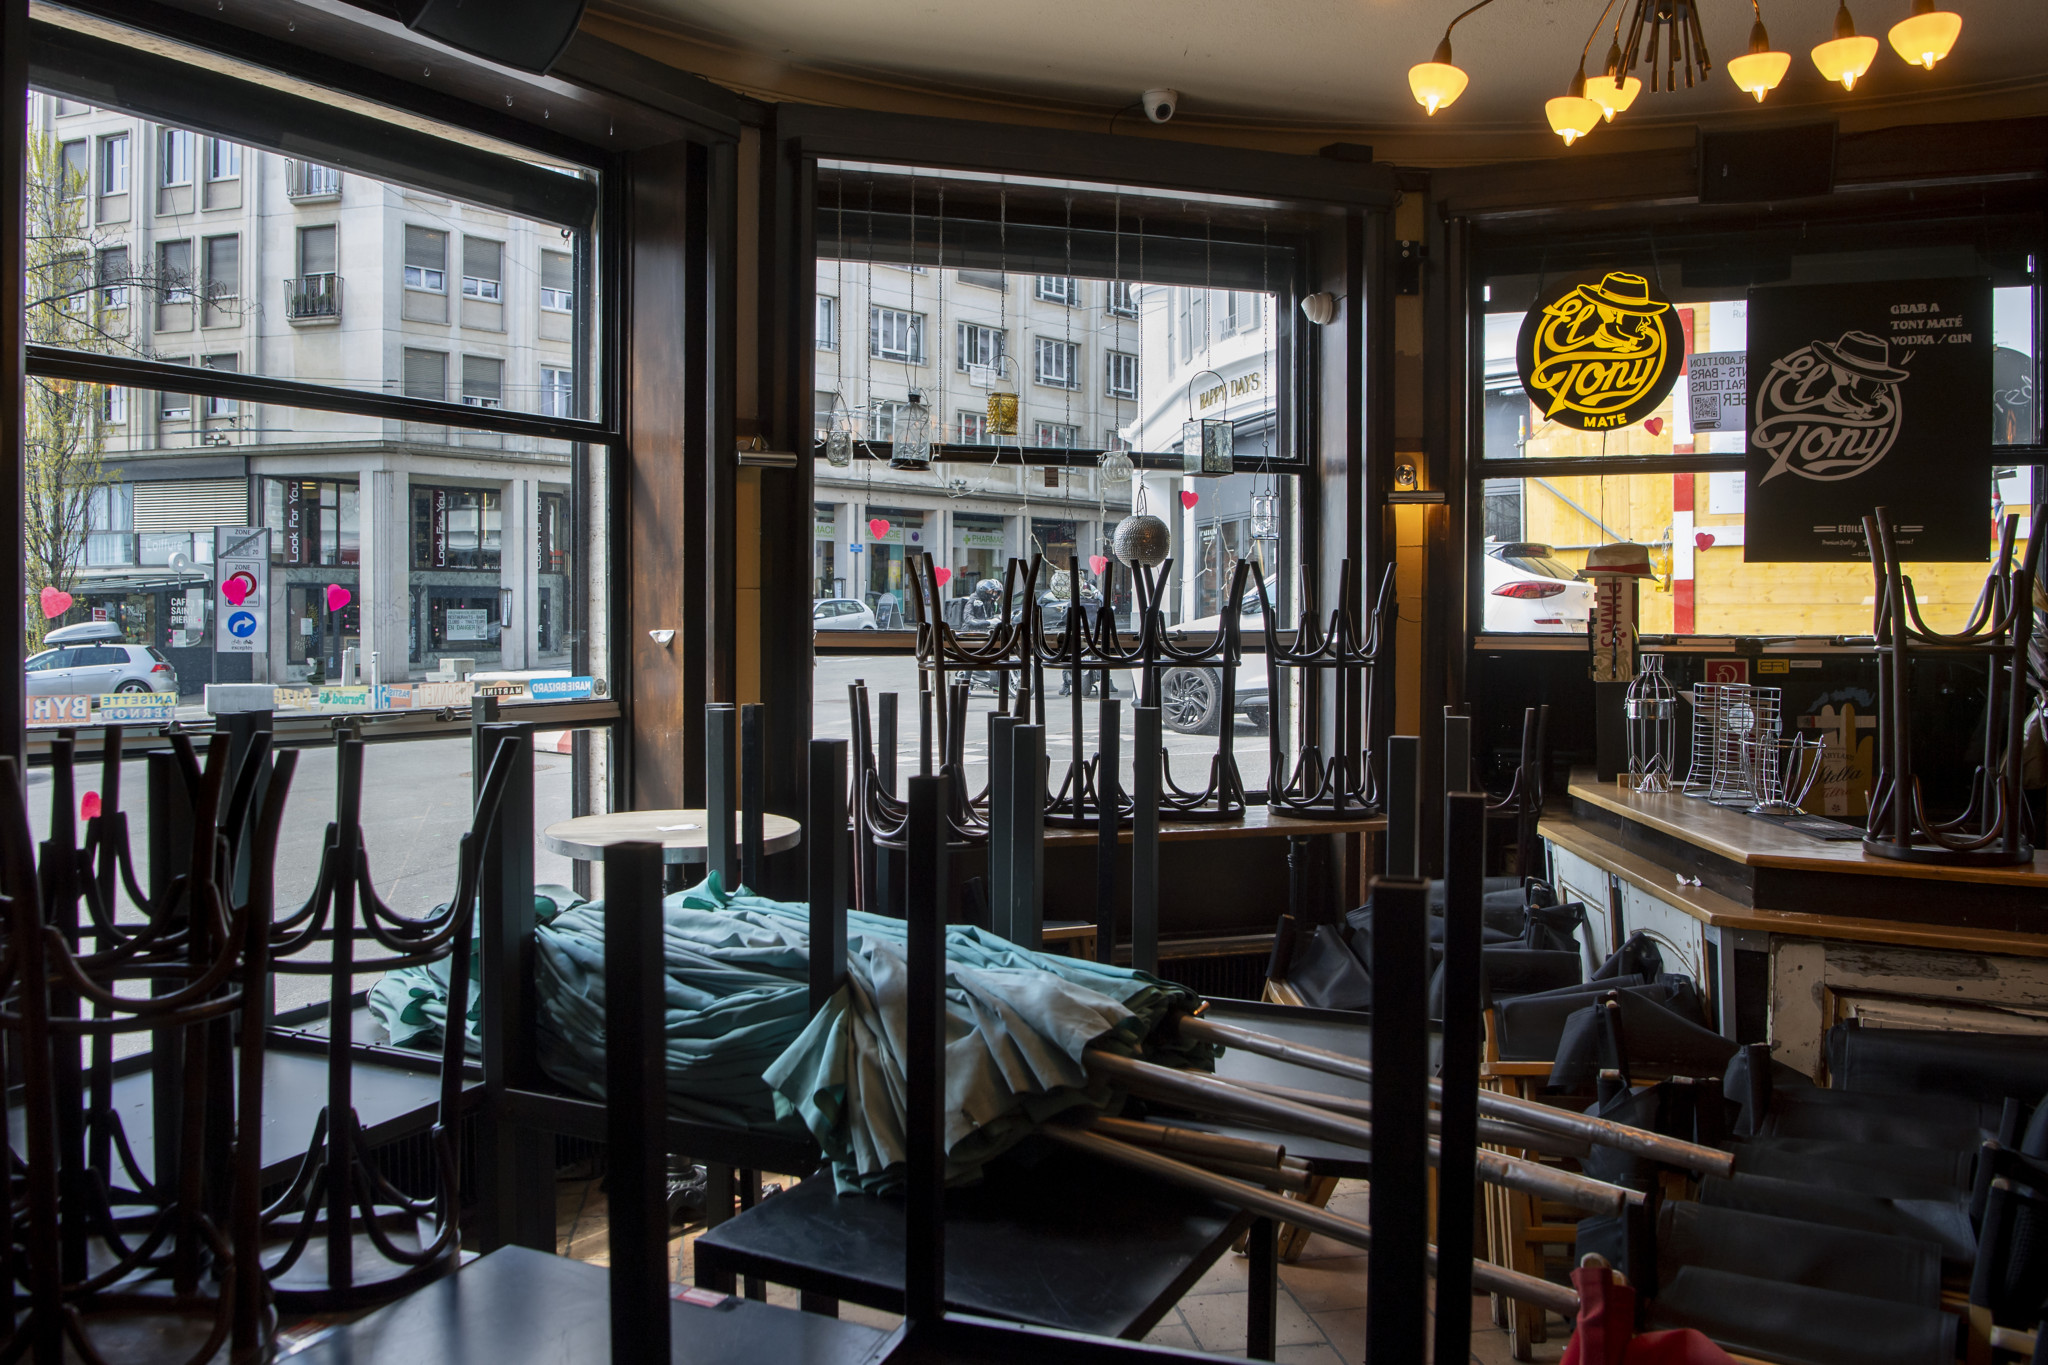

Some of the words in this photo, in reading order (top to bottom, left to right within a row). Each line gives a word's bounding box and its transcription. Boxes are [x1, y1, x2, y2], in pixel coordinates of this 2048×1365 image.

[1890, 304, 1927, 315] GRAB
[1930, 302, 1940, 313] A
[1891, 320, 1924, 330] TONY
[1926, 315, 1963, 329] MATÉ
[1890, 335, 1935, 346] VODKA
[1948, 333, 1972, 344] GIN
[1200, 382, 1227, 410] HAPPY
[1230, 371, 1260, 398] DAYS
[1530, 350, 1658, 421] Tony
[1583, 412, 1628, 428] MATE
[1751, 414, 1892, 488] Tony
[289, 481, 299, 505] You
[436, 490, 446, 514] You
[289, 507, 299, 528] For
[436, 517, 446, 536] For
[1838, 524, 1864, 533] ETOILE
[145, 538, 183, 552] Coiffure
[289, 532, 299, 563] Look
[436, 539, 446, 567] Look
[171, 606, 193, 615] SAINT
[171, 615, 198, 624] PIERRE
